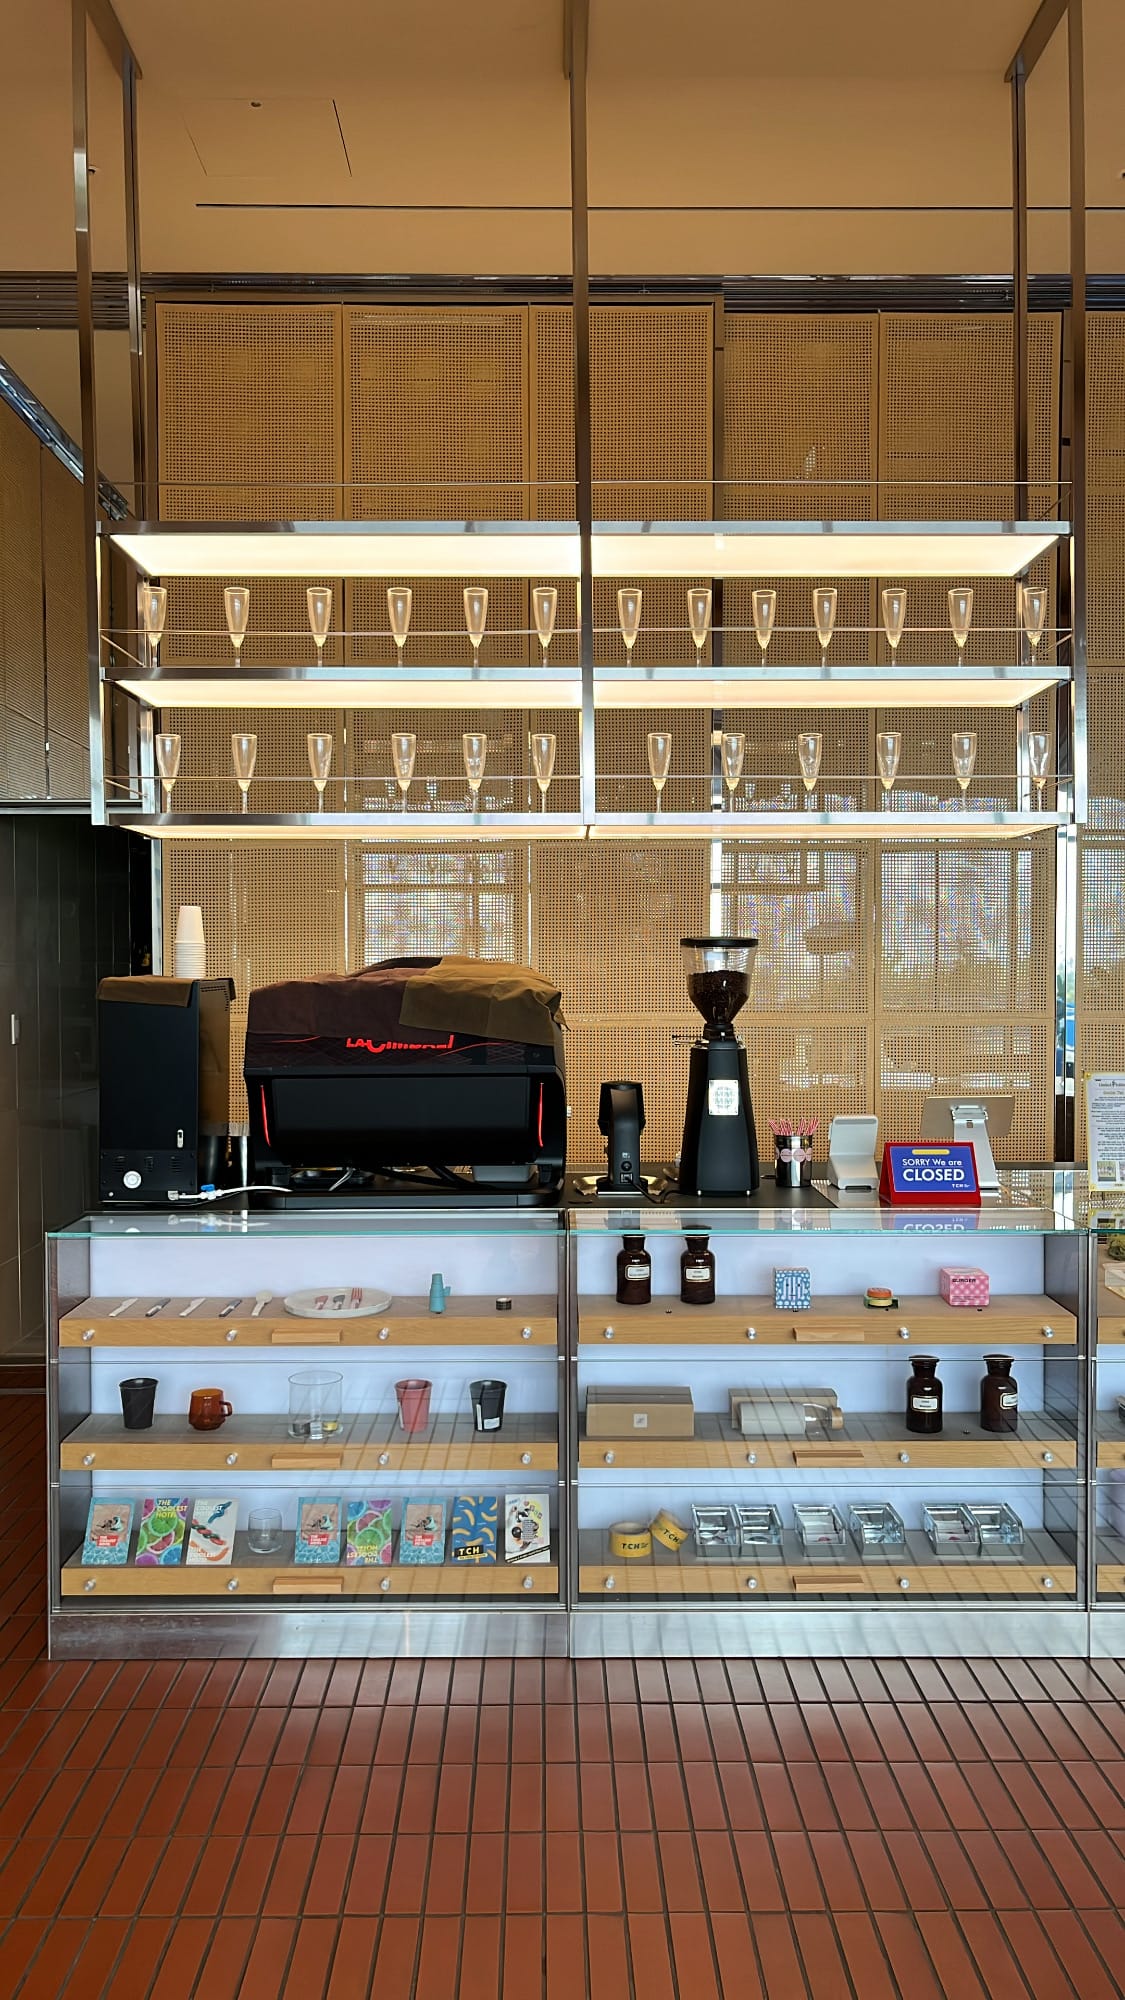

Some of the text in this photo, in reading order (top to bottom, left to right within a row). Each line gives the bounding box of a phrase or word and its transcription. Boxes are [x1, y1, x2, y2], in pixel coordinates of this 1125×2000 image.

[902, 1168, 965, 1182] CLOSED
[663, 1528, 680, 1543] TCH
[459, 1546, 480, 1556] TCH
[622, 1542, 640, 1550] TCH
